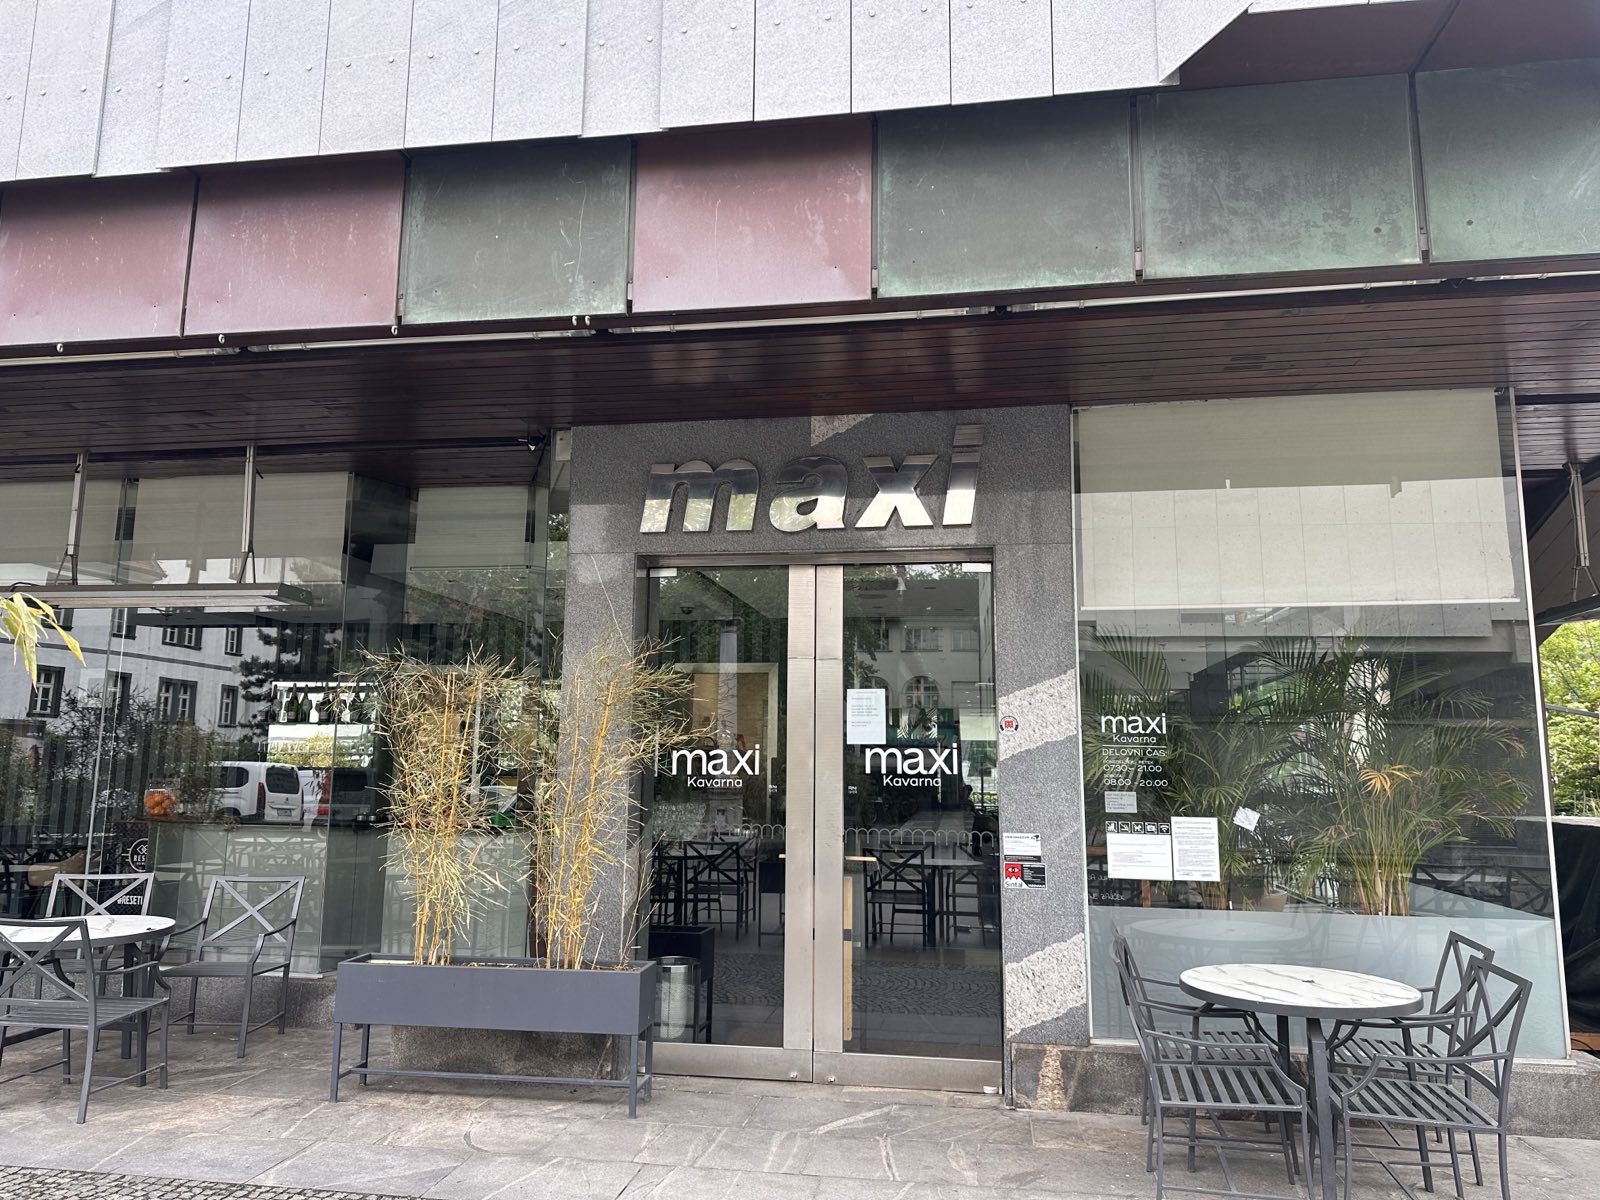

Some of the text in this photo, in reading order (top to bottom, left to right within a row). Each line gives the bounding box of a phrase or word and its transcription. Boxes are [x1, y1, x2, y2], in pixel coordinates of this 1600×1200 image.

[639, 424, 985, 533] maxi
[1101, 713, 1167, 734] maxi
[1112, 734, 1157, 743] Kavarna
[1102, 748, 1144, 756] DELOVNI
[671, 744, 760, 775] maxi
[865, 743, 958, 775] maxi
[1137, 764, 1162, 772] 21.00
[687, 776, 743, 787] Kavarna
[883, 775, 941, 787] Kavarna
[1139, 779, 1168, 787] 20.00
[1005, 880, 1023, 888] Sintal
